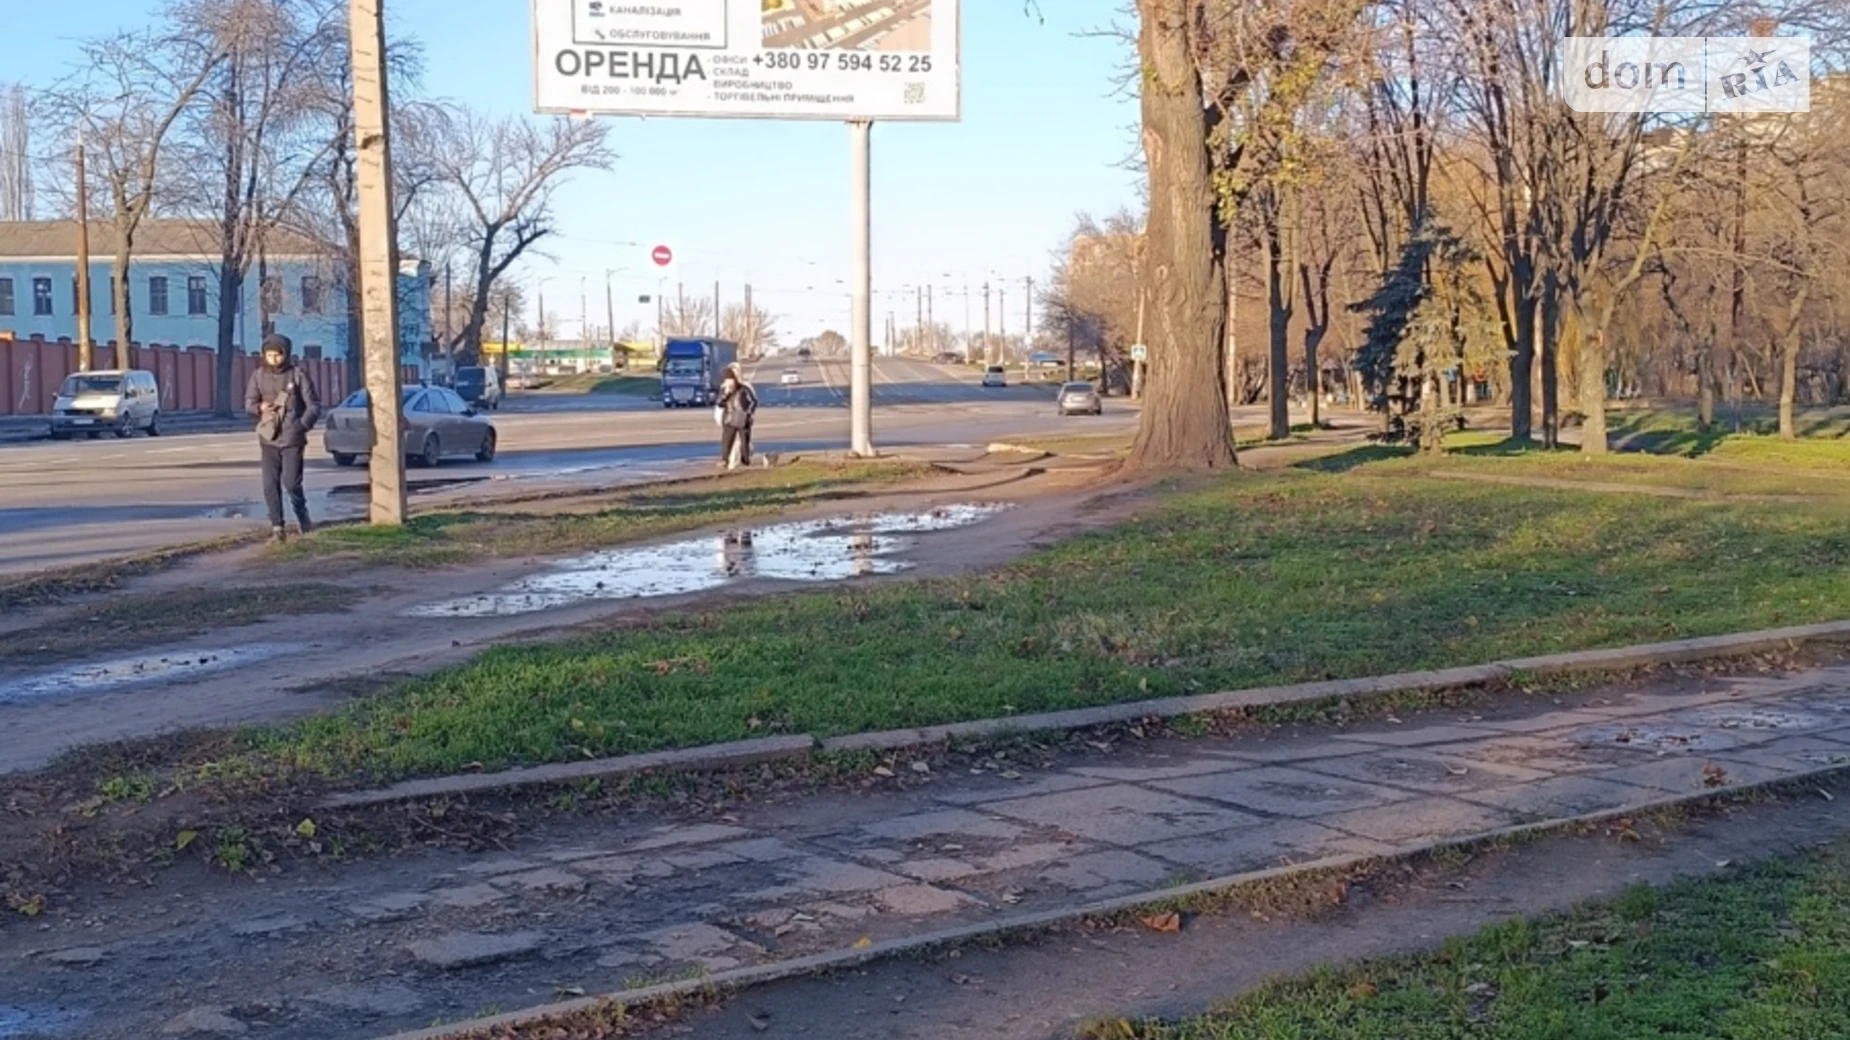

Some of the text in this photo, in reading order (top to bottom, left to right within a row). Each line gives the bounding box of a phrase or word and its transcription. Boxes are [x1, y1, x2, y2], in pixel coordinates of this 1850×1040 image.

[609, 6, 682, 17] КАНАЛІЗАЦІЯ
[609, 29, 711, 41] ОБСЛУГОВУВАННЯ
[555, 49, 707, 85] ОРЕНДА
[753, 52, 932, 72] +380 97 594 52 25
[712, 67, 750, 78] СКЛАД
[581, 85, 601, 96] ВІД
[602, 85, 621, 95] 200
[630, 86, 647, 96] 100
[649, 87, 668, 97] 000
[713, 80, 793, 91] ВИРОБНИЦТВО
[714, 92, 855, 104] ТОРГІВЕЛЬНІ ПРИМІЩЕННЯ
